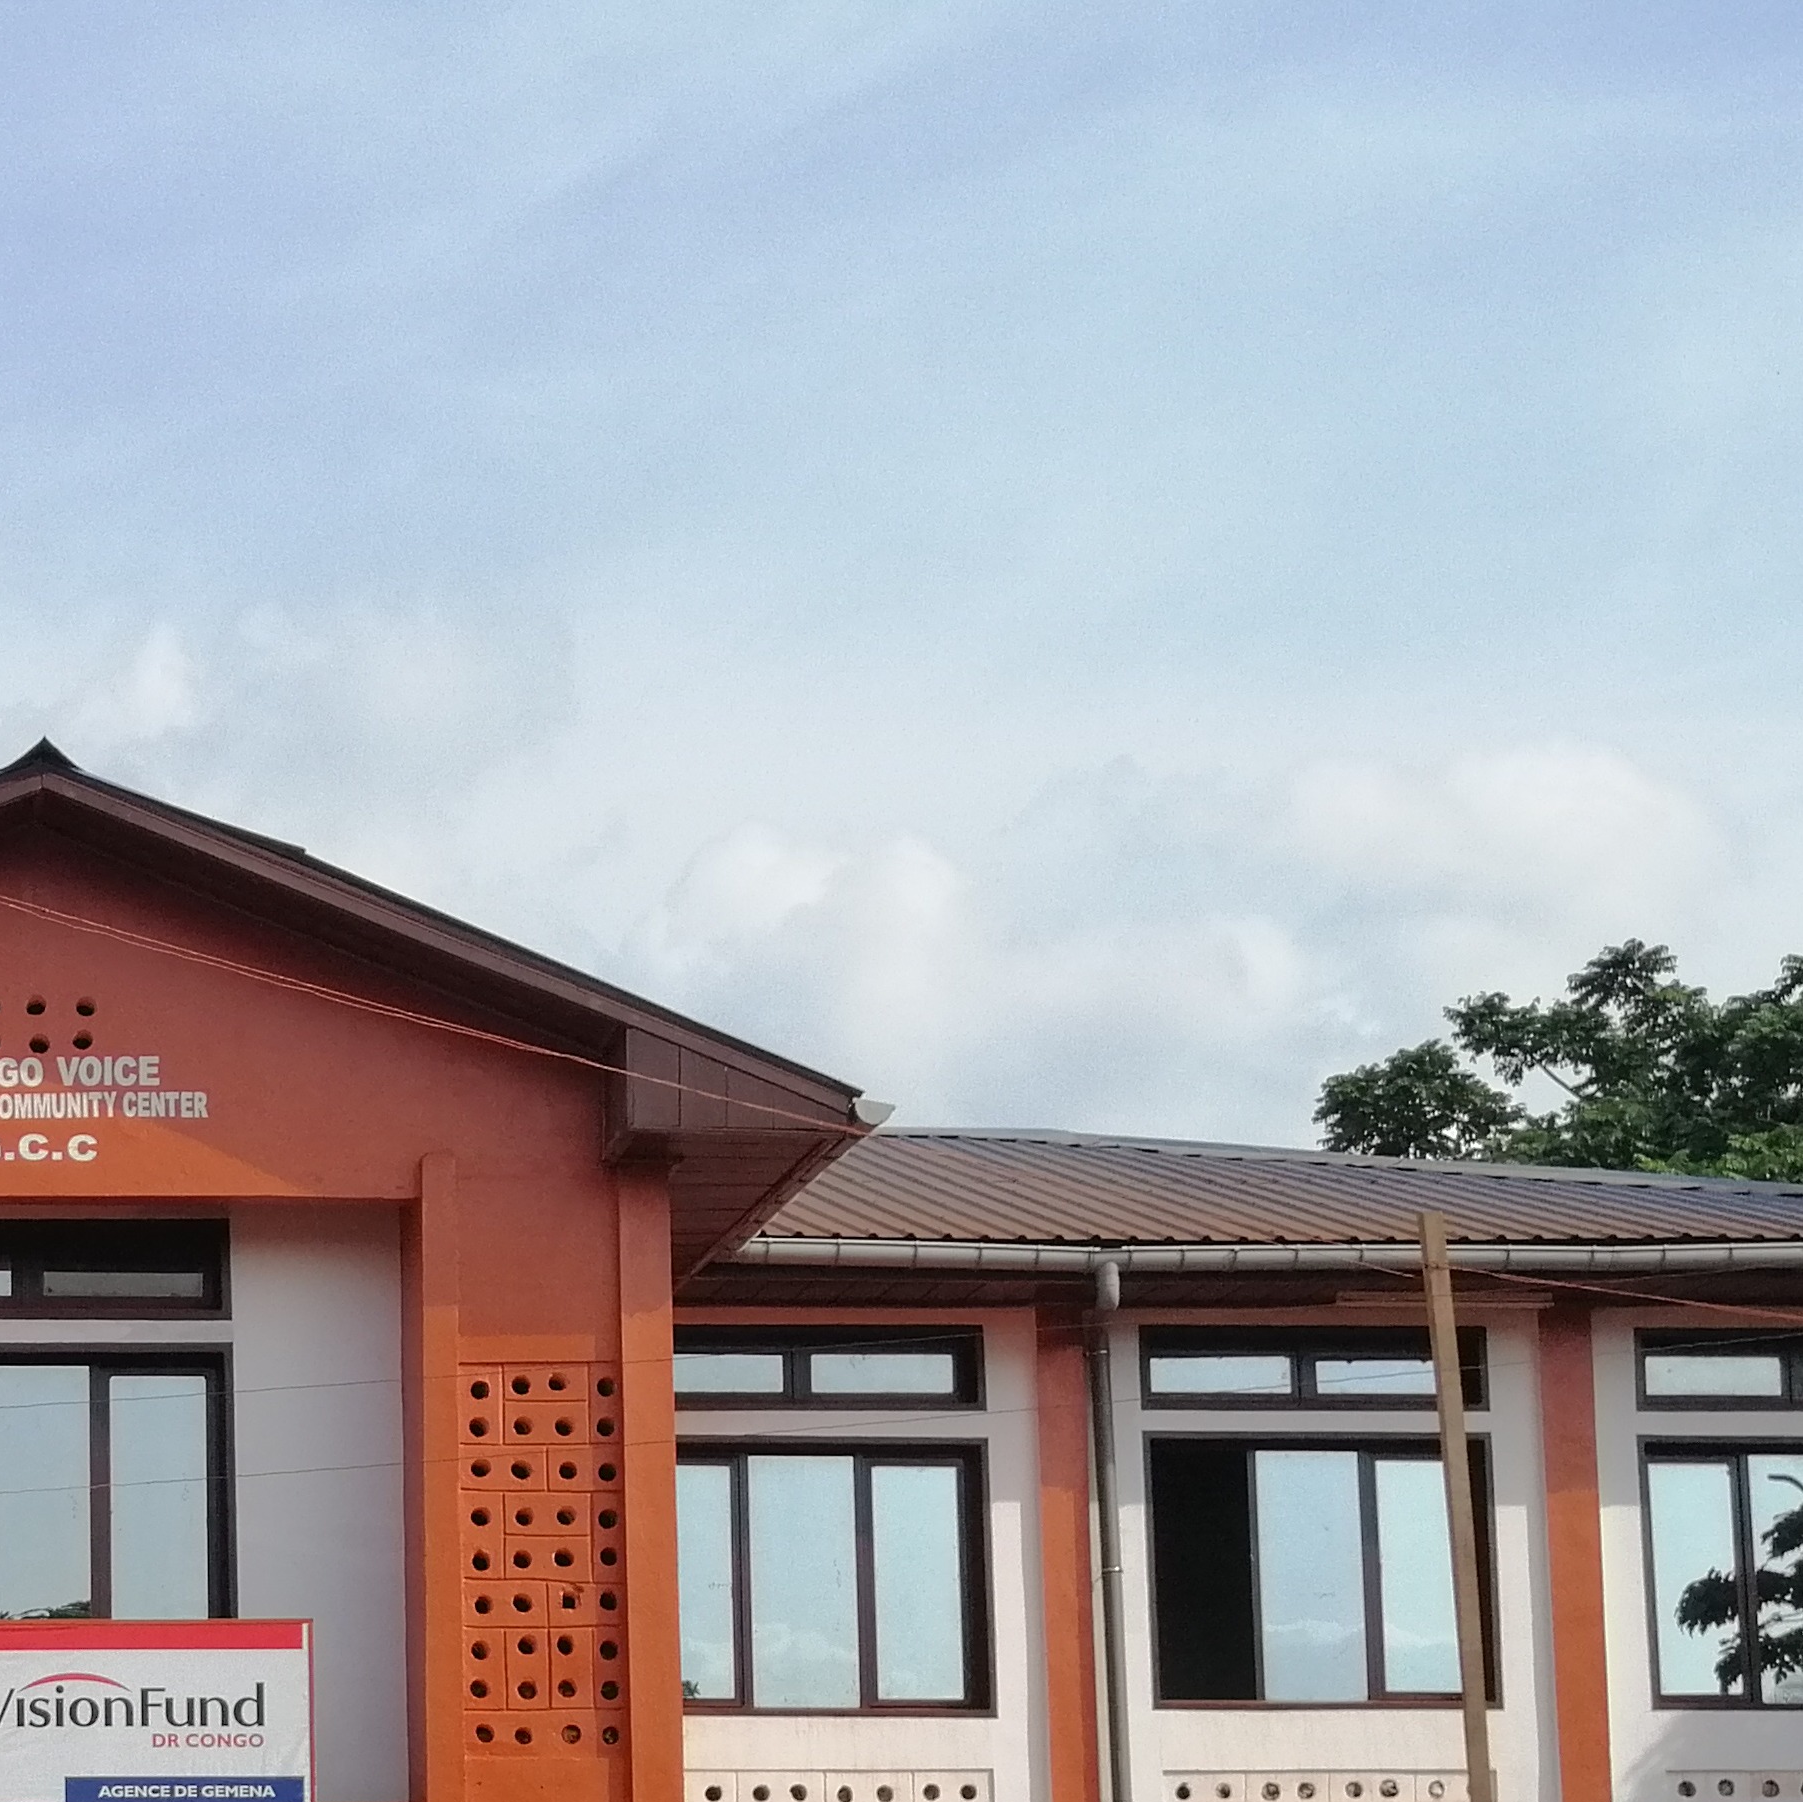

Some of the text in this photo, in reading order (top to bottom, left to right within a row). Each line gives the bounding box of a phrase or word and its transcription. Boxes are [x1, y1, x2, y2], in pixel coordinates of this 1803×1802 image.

[57, 1056, 160, 1087] VOICE
[122, 1091, 209, 1119] CENTER
[152, 1733, 265, 1748] DR CONGO
[97, 1783, 277, 1799] AGENCE DE GEMENA
